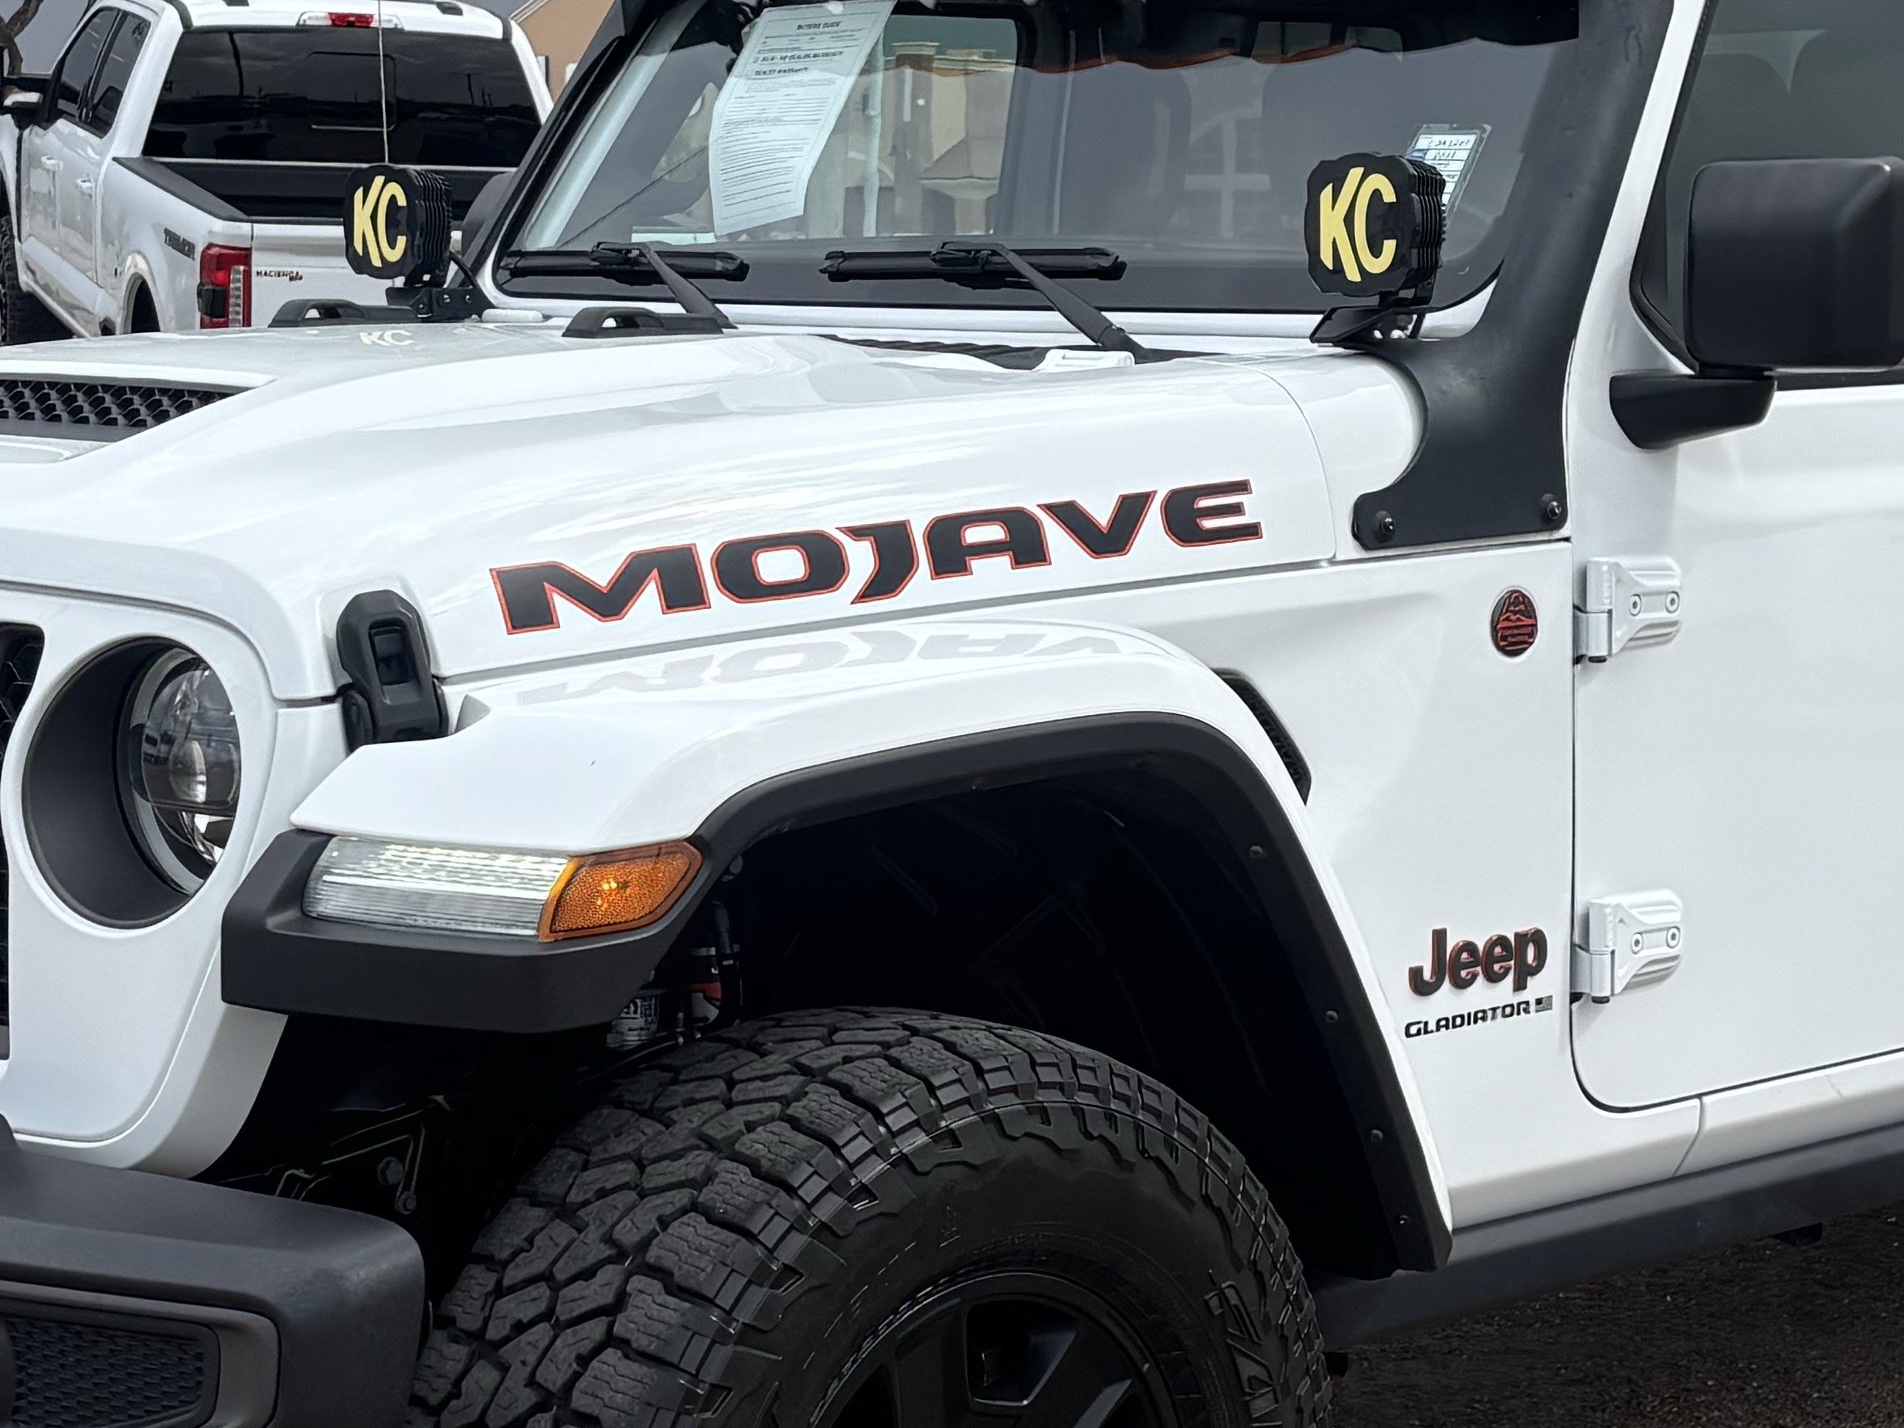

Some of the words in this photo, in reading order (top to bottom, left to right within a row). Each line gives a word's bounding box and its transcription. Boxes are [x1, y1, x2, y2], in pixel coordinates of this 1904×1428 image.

[353, 175, 407, 268] KC
[1320, 167, 1397, 282] KC
[489, 478, 1264, 635] MOJAVE
[1408, 926, 1548, 997] Jeep
[1404, 1000, 1531, 1039] GLADIATOR
